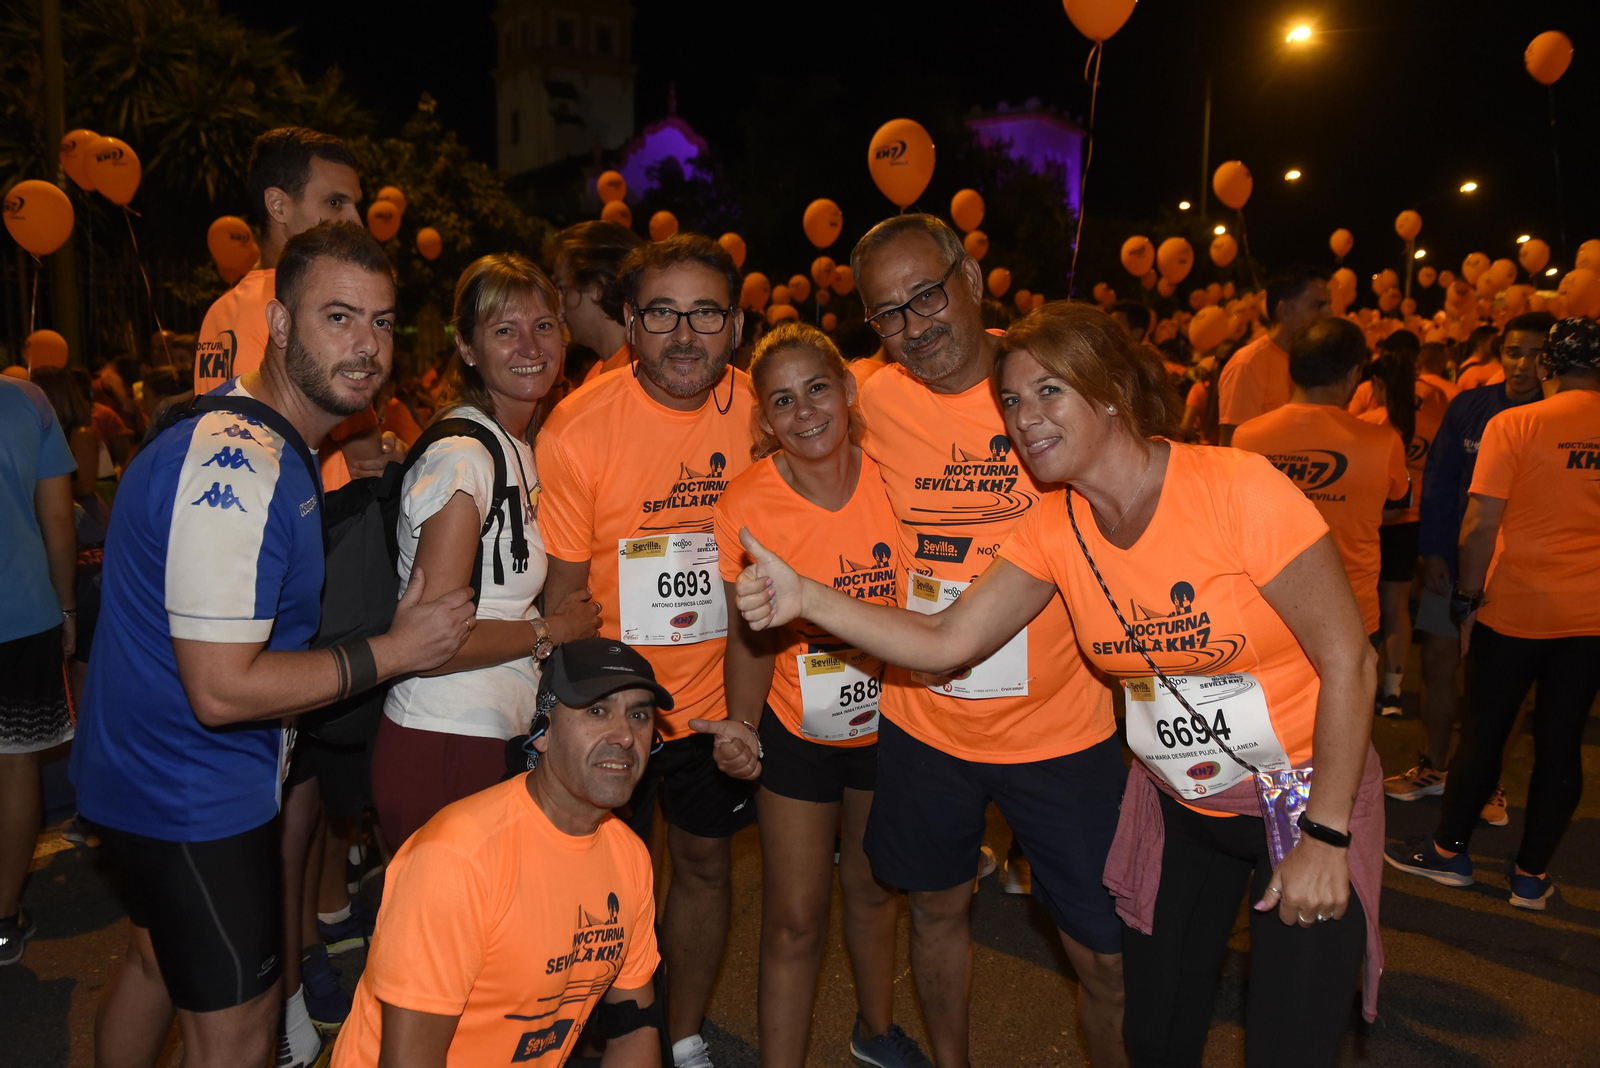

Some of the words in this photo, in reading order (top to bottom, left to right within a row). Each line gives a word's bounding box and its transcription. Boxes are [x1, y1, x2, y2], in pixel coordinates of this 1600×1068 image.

[1557, 442, 1600, 450] NOCTURN
[1264, 454, 1309, 462] OCTURNA
[1566, 451, 1600, 469] KH
[943, 464, 1019, 476] NOCTURNA
[914, 477, 975, 491] SEVILLA
[642, 495, 699, 513] SEVILLA
[700, 492, 723, 507] KH
[657, 569, 711, 598] 6693
[1125, 611, 1211, 637] NOCTURNA
[839, 676, 883, 707] 588
[1156, 708, 1232, 749] 6694
[1155, 753, 1171, 761] MARIA
[1171, 751, 1198, 760] DESSIREE
[1198, 749, 1218, 757] PUJOL
[572, 926, 625, 947] NOCTURNA
